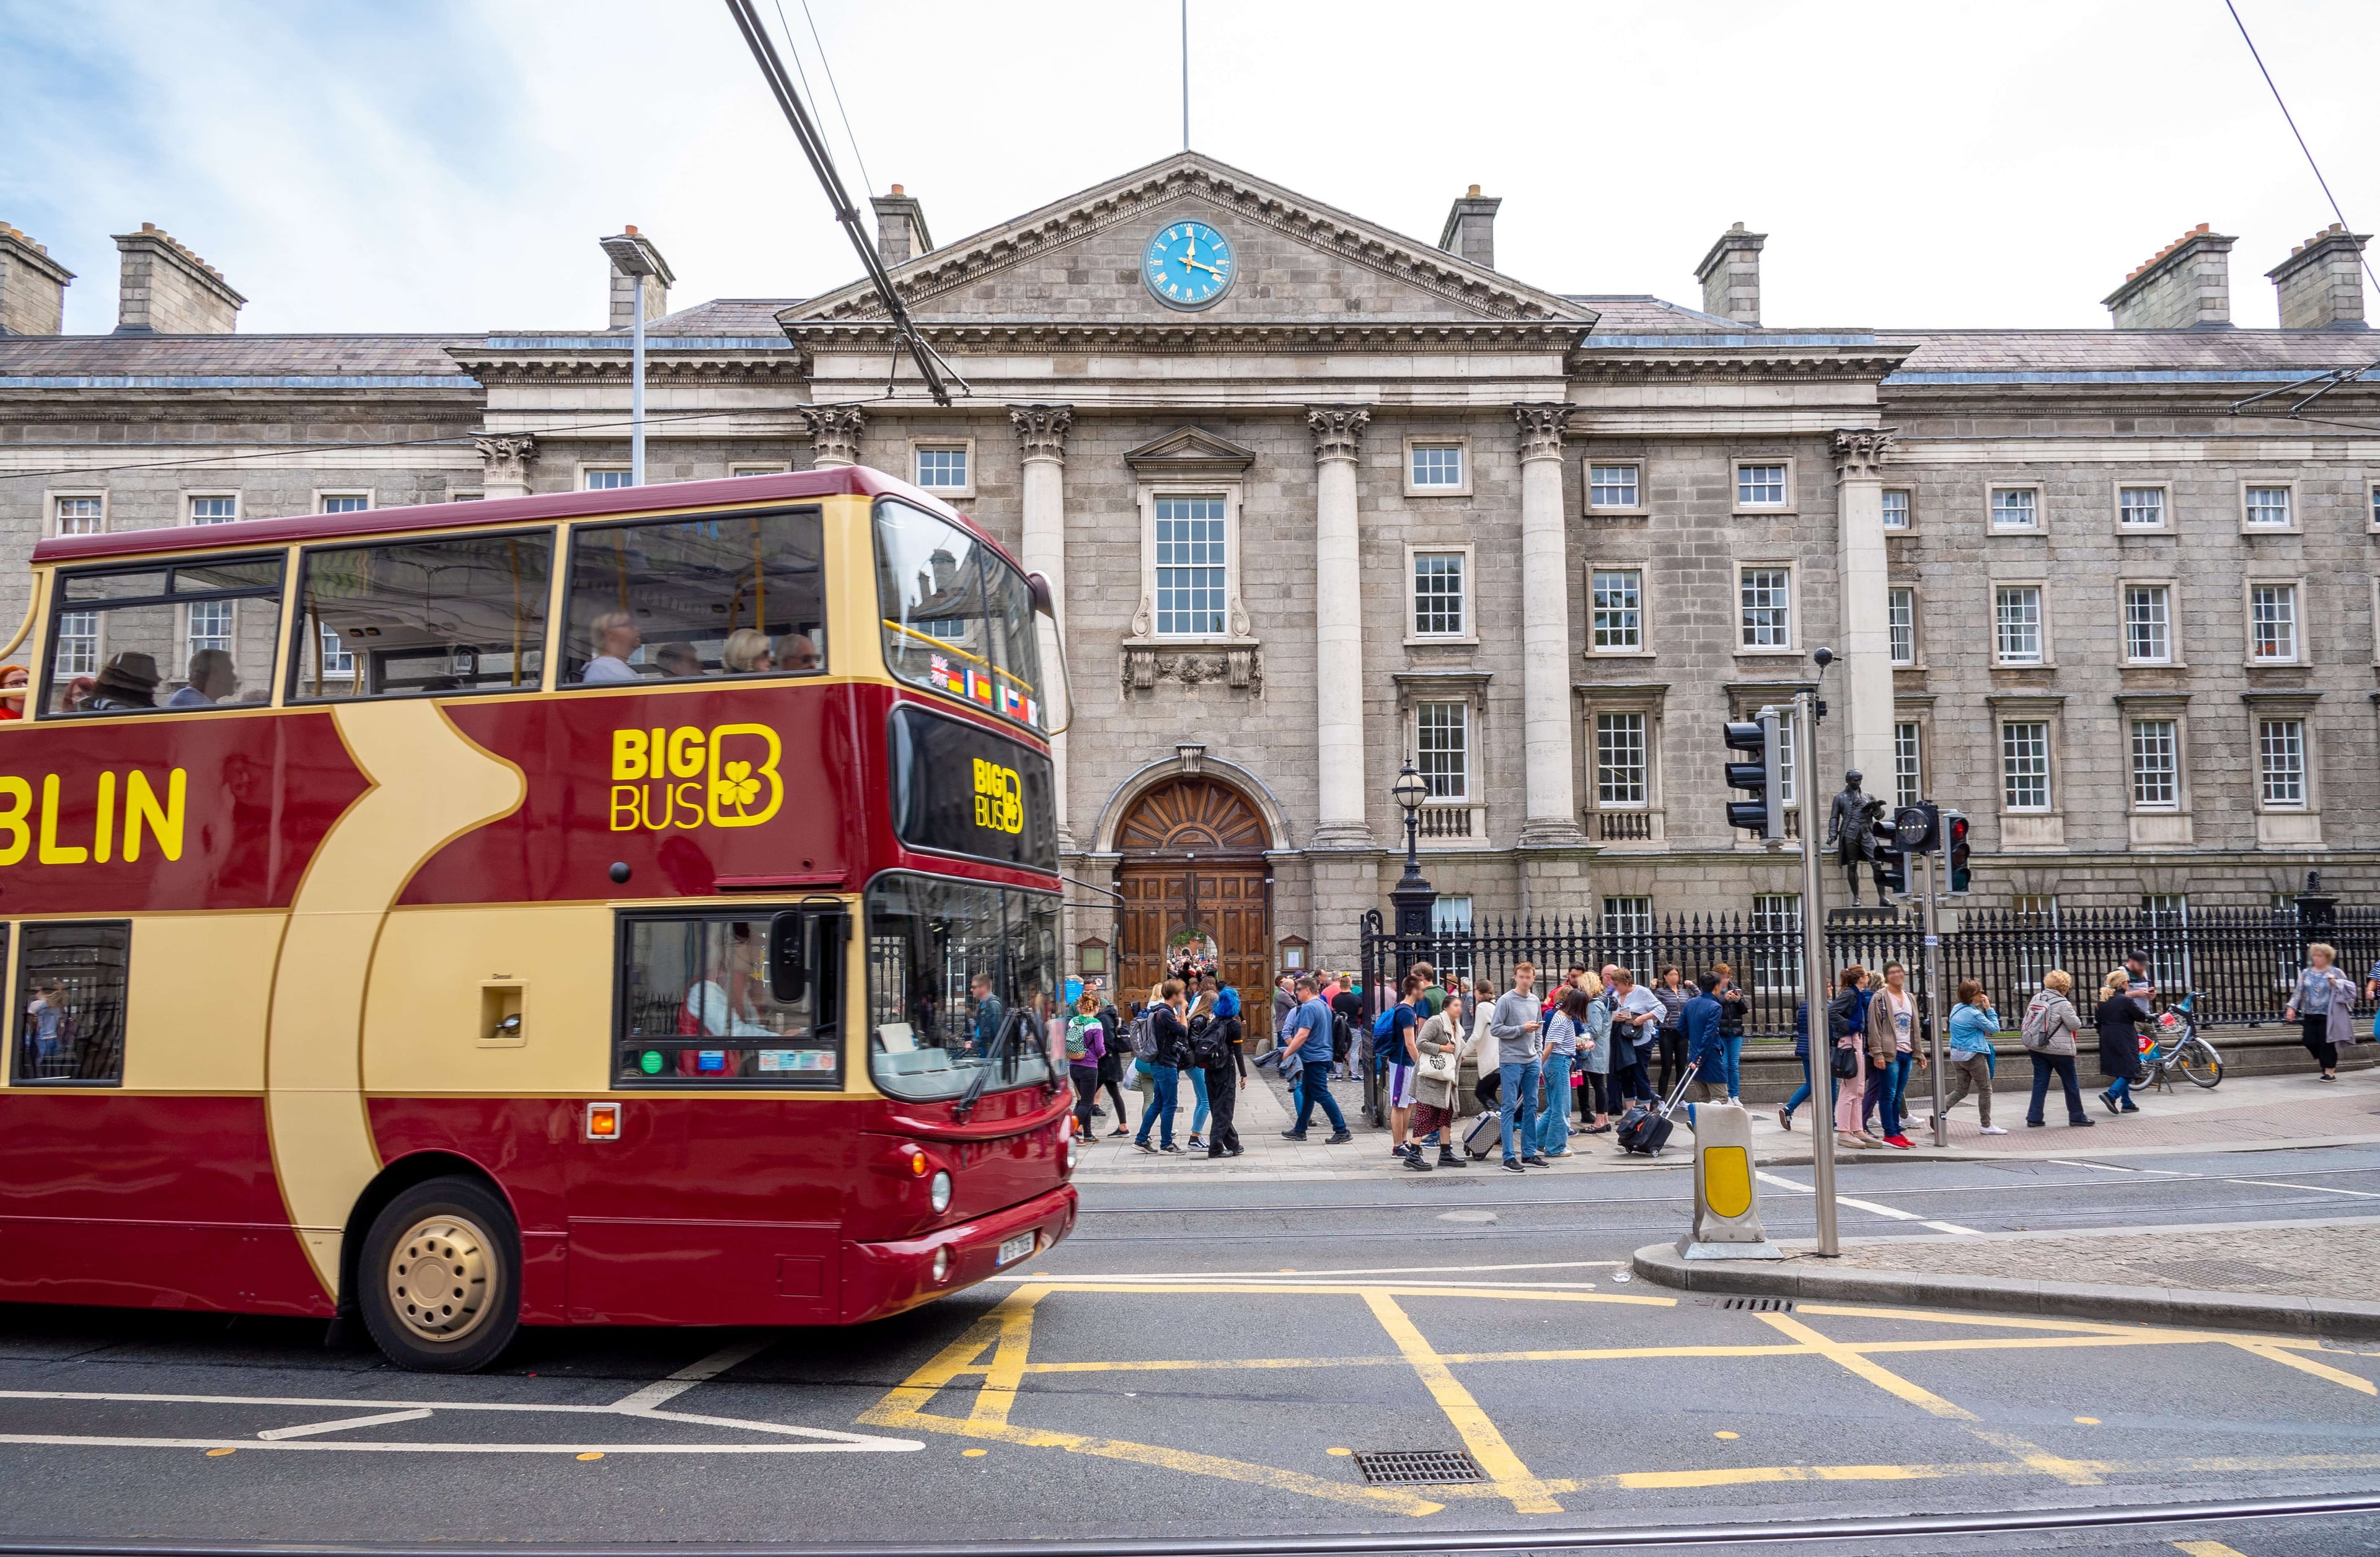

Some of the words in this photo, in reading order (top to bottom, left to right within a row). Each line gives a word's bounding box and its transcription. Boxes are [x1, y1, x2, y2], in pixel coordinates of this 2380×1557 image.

[611, 725, 707, 780] BIG
[972, 757, 1002, 798] BIG
[610, 782, 705, 831] BUS
[974, 795, 1005, 831] BUS
